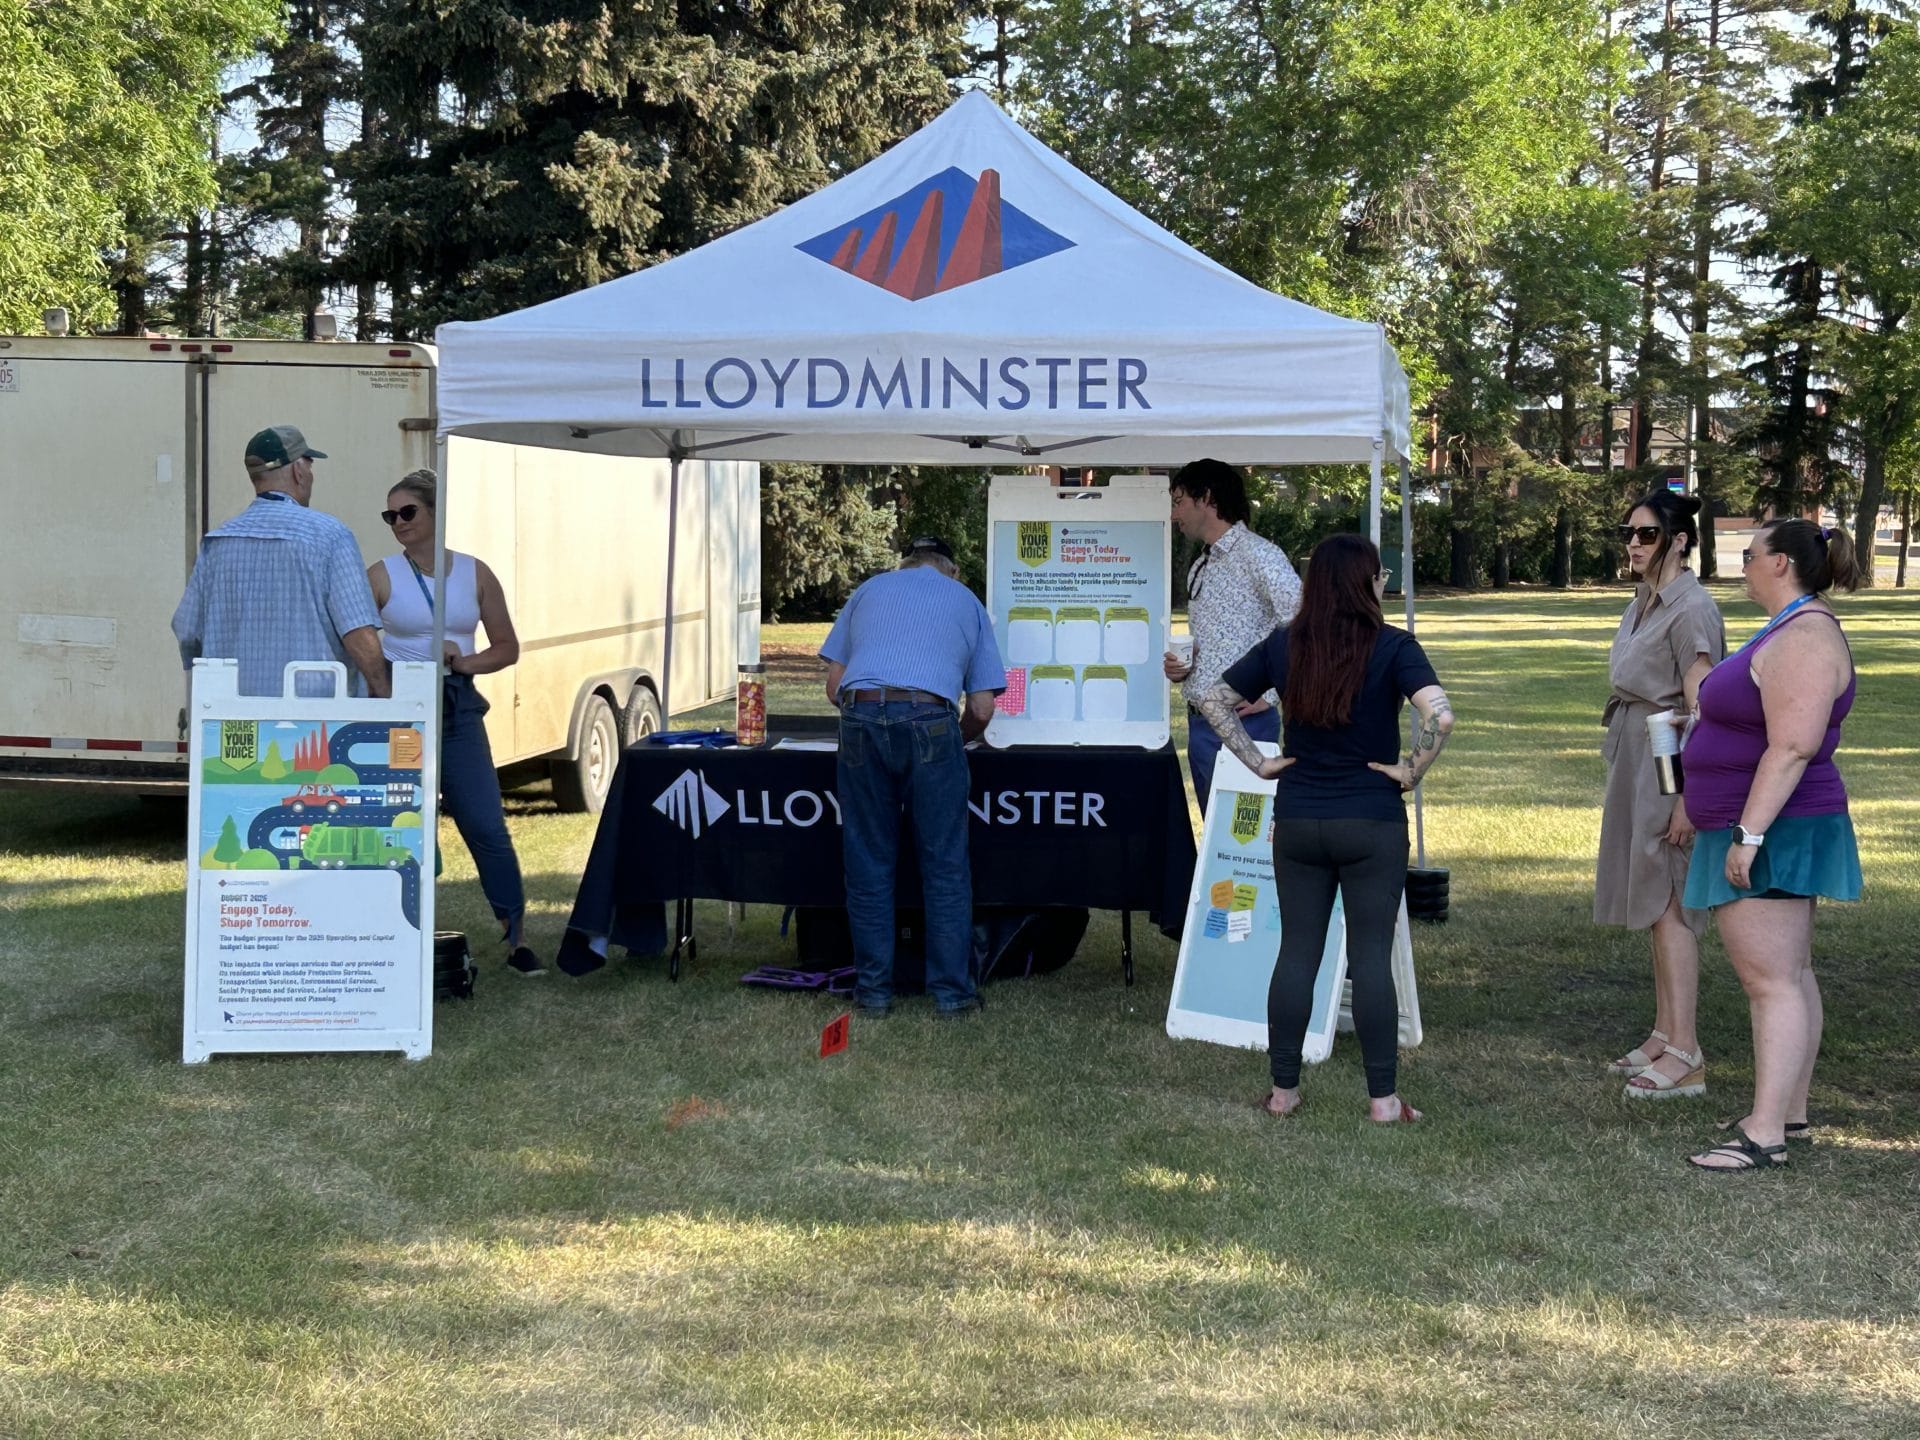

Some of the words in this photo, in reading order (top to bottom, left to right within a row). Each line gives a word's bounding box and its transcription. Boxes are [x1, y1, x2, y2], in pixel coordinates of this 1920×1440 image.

[641, 356, 1153, 411] LLOYDMINSTER
[1021, 521, 1048, 533] SHARE
[1021, 534, 1048, 546] YOUR
[1021, 546, 1048, 559] VOICE
[225, 720, 254, 733] SHARE
[225, 733, 254, 746] YOUR
[225, 746, 254, 759] VOICE
[736, 788, 1107, 827] LLOYNSTER
[1236, 807, 1260, 822] YOUR
[1233, 821, 1258, 835] VOICE
[220, 904, 259, 917] Engage
[262, 904, 297, 917] Today.
[220, 917, 253, 929] Shape
